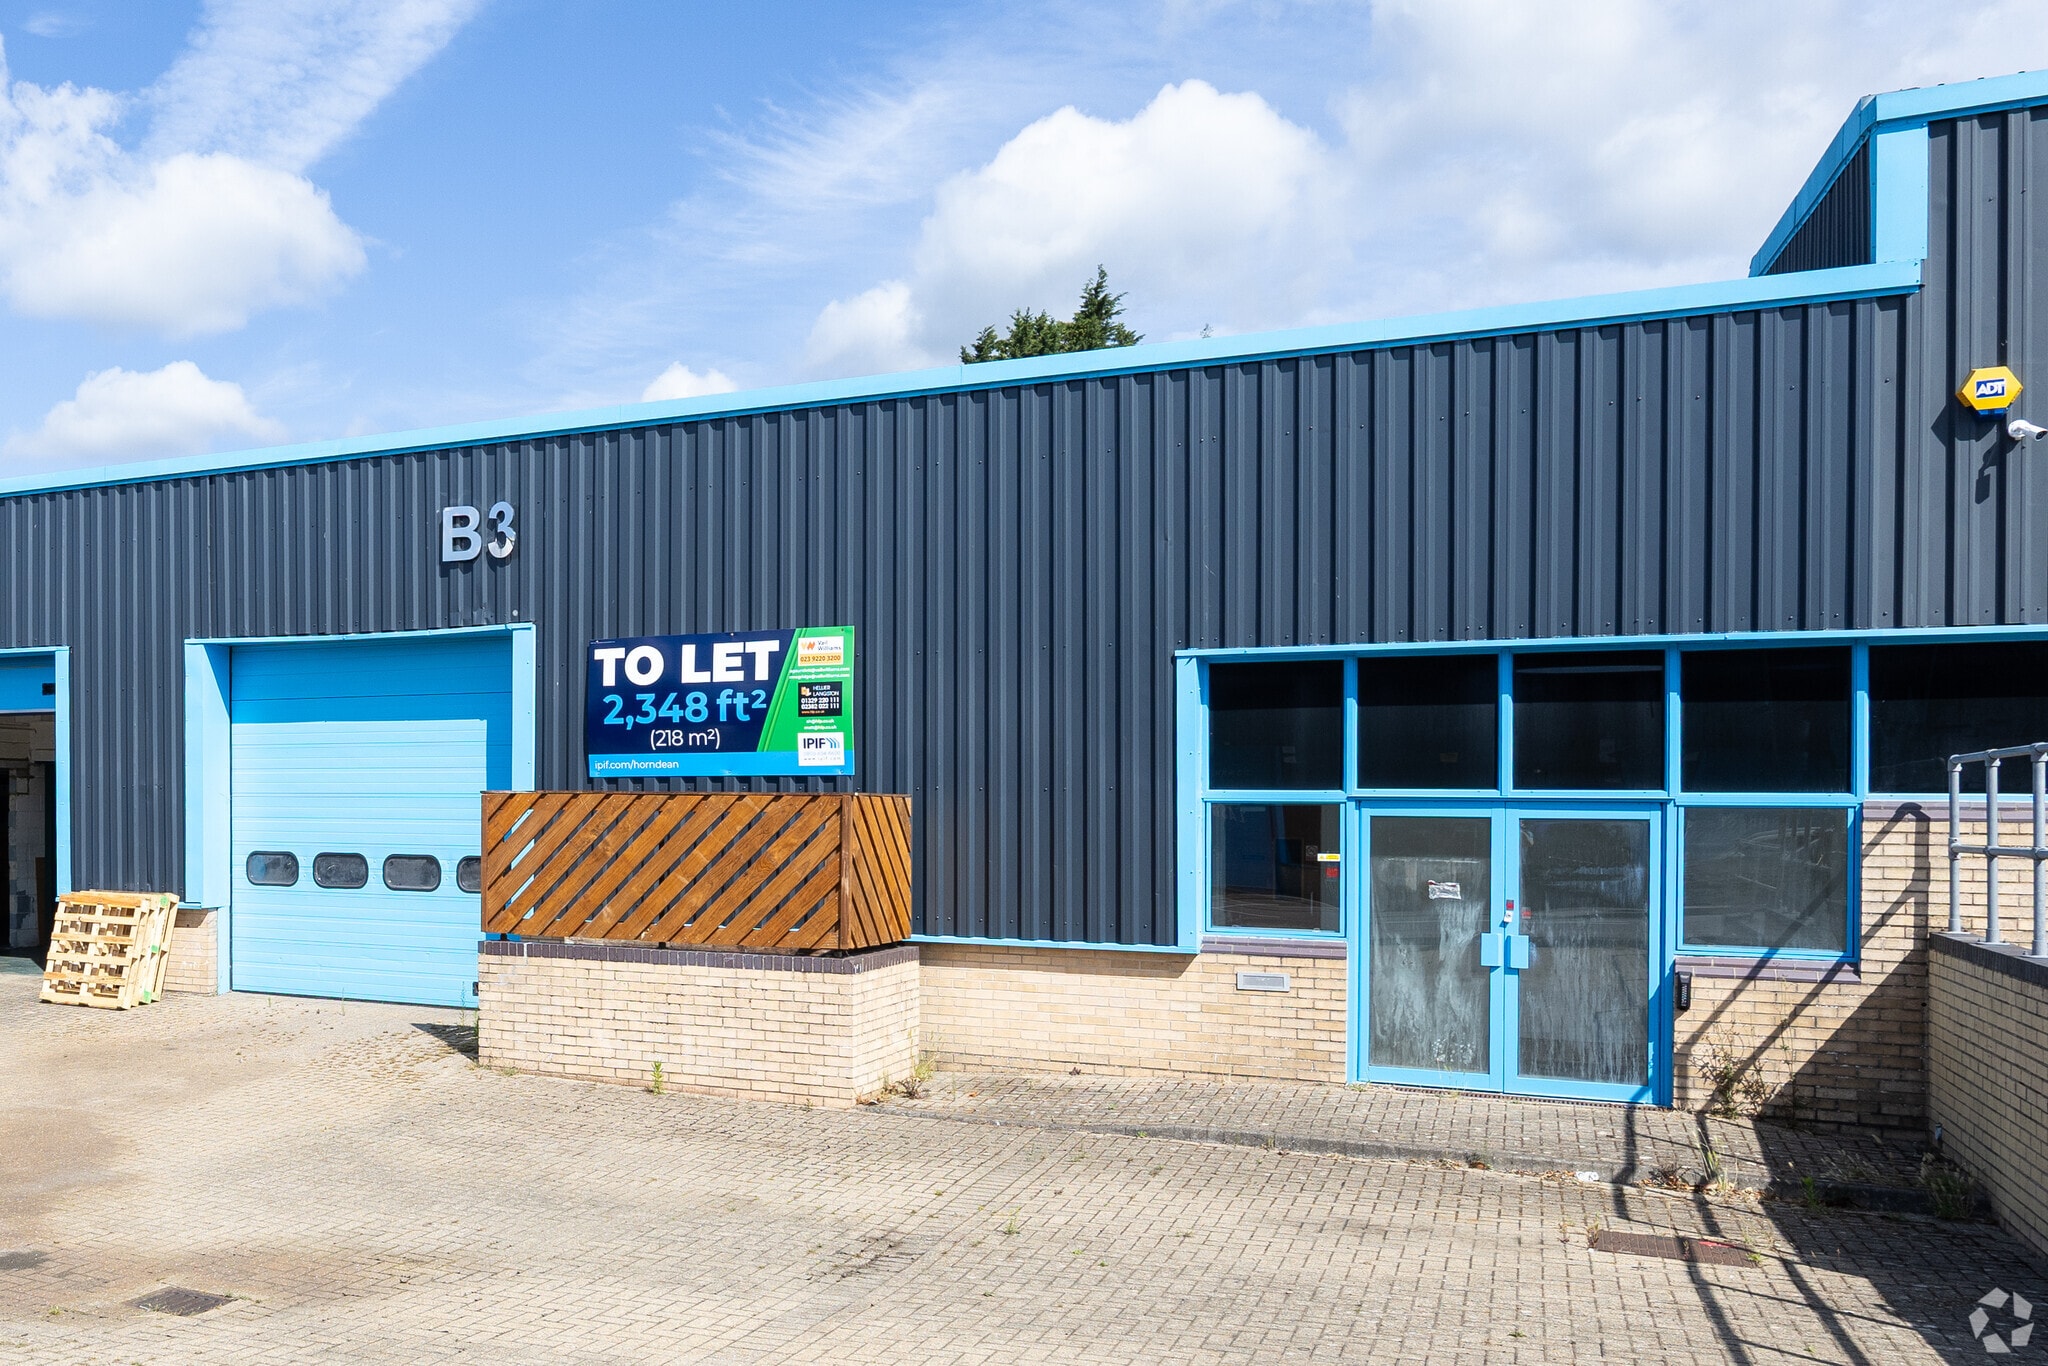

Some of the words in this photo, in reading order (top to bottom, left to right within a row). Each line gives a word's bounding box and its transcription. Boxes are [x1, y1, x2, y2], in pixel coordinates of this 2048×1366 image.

[1976, 380, 2005, 396] ADT
[442, 501, 516, 562] B3
[594, 645, 664, 687] TO
[681, 640, 779, 684] LET
[603, 692, 709, 730] 2,348
[650, 729, 684, 751] (218
[688, 728, 720, 750] m²)
[803, 737, 826, 749] IPIF
[594, 759, 679, 771] ipif.com/horndean
